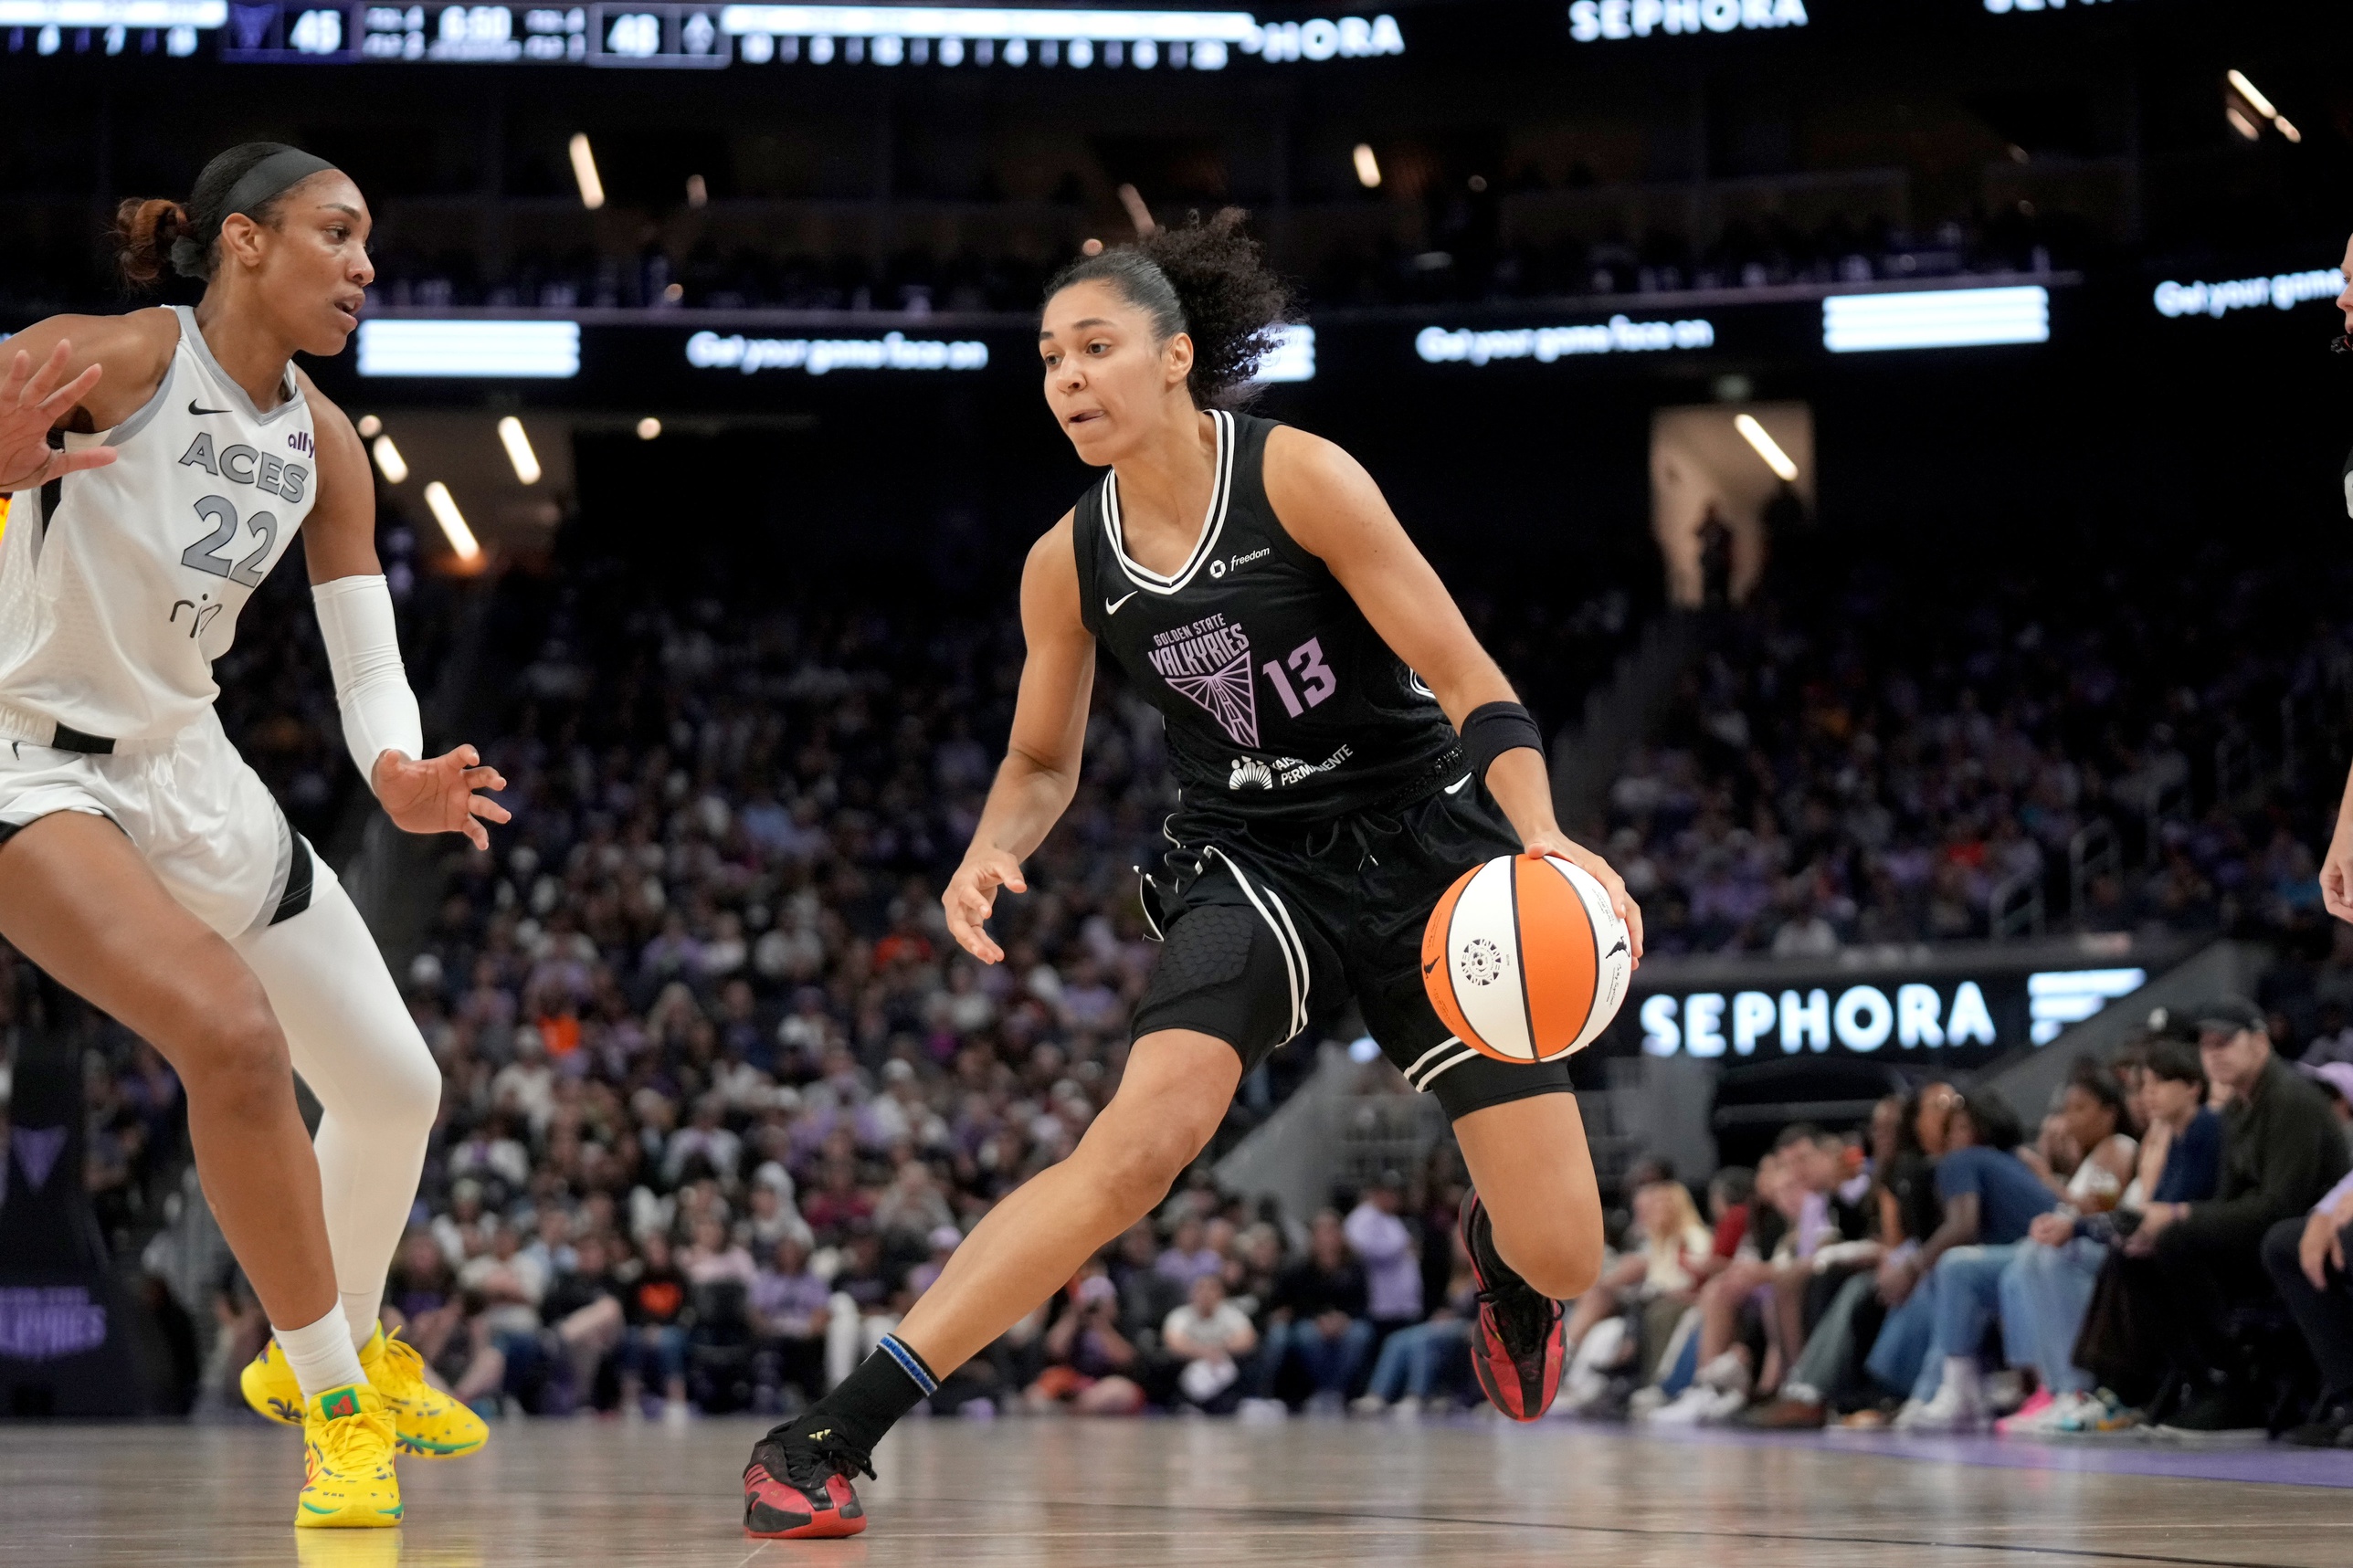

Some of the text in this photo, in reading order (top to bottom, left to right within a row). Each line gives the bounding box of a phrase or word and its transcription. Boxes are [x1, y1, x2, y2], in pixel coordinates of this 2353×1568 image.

[1568, 0, 1809, 42] SEPHORA
[178, 431, 309, 503] ACES
[288, 431, 315, 458] ally
[181, 494, 278, 588] 22
[1230, 547, 1271, 572] freedom
[1147, 622, 1250, 676] VALKYRIES
[1153, 613, 1226, 647] GOLDEN STATE
[1262, 637, 1337, 719] 13
[1281, 743, 1354, 786] PERMNENTE
[1640, 981, 1997, 1058] SEPHORA
